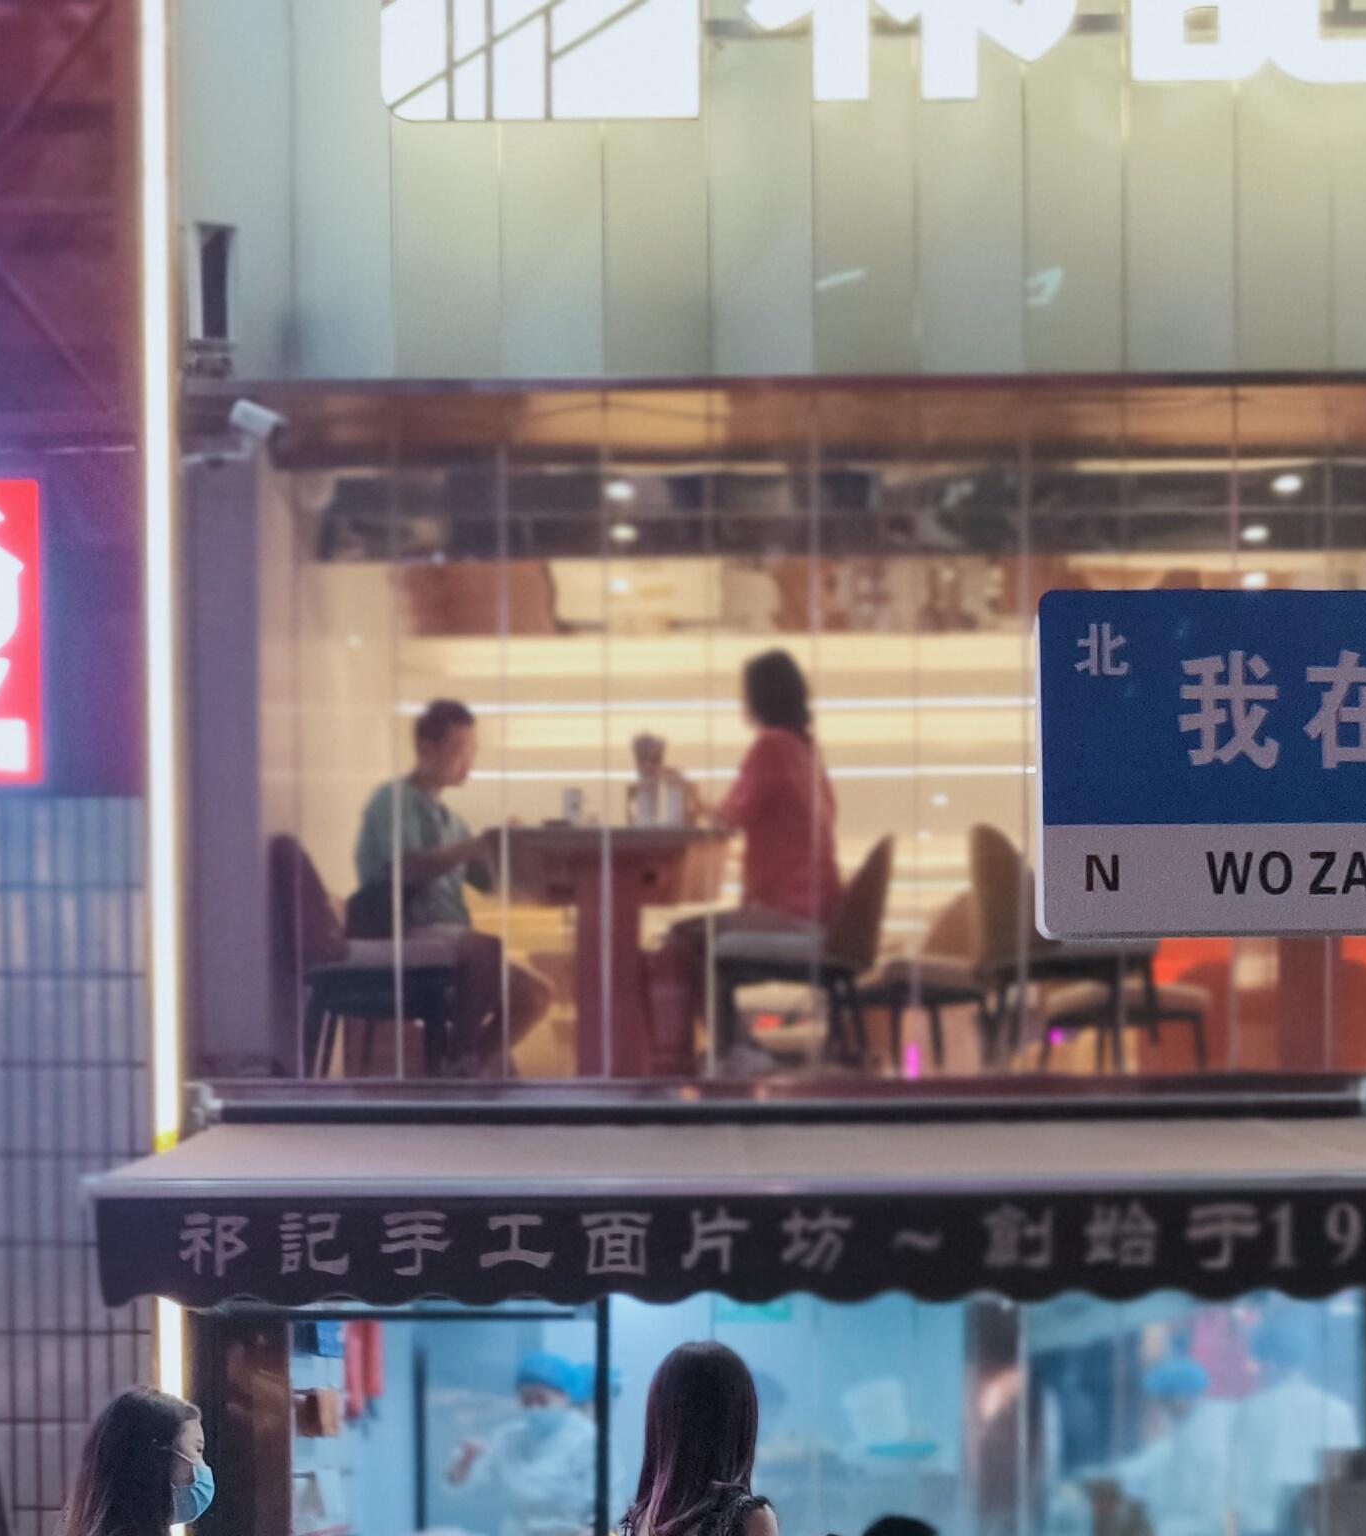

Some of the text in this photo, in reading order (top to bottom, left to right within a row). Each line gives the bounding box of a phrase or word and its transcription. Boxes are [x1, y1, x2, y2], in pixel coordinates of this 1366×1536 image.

[1075, 623, 1130, 677] 北
[1084, 853, 1121, 892] N
[1206, 851, 1293, 895] WO
